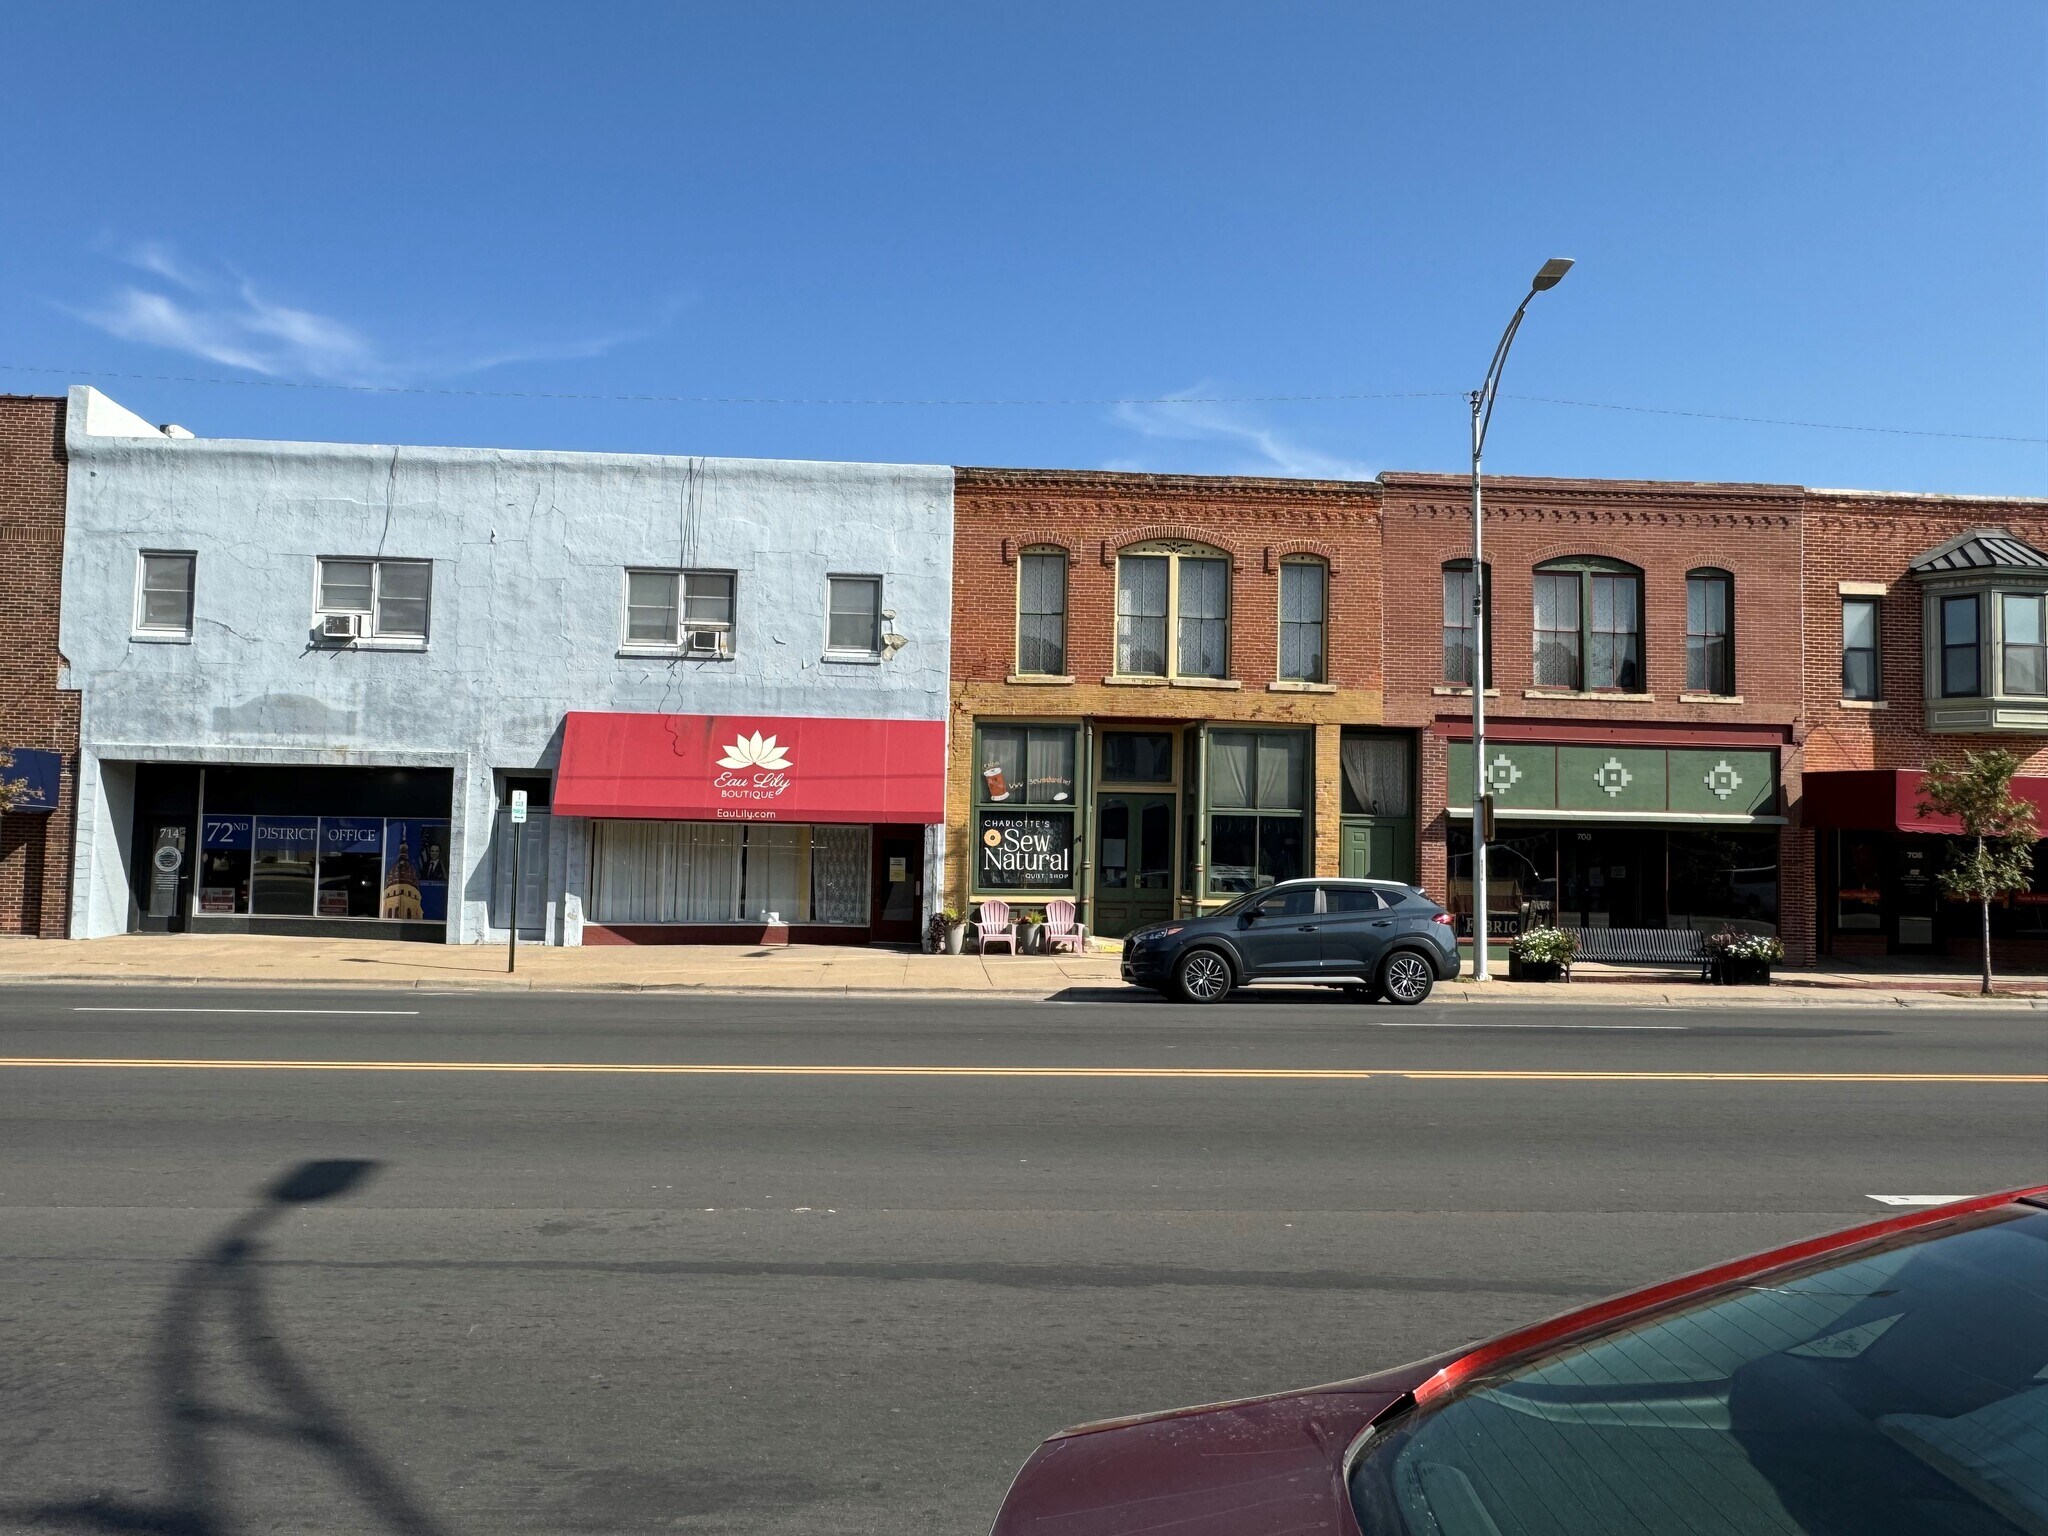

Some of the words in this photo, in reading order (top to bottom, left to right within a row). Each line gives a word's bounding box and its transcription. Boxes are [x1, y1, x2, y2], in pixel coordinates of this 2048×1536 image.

[714, 771, 748, 788] Eau
[753, 772, 791, 796] Lily
[721, 789, 775, 800] BOUTIQUE
[717, 808, 776, 820] EauLily.com
[984, 819, 1050, 828] CHARLOTTE'S
[159, 828, 180, 839] 714
[257, 827, 316, 840] DISTRICT
[328, 829, 376, 841] OFFICE
[1004, 828, 1050, 852] Sew
[983, 847, 1069, 871] Natural
[1465, 917, 1518, 934] FBRIC
